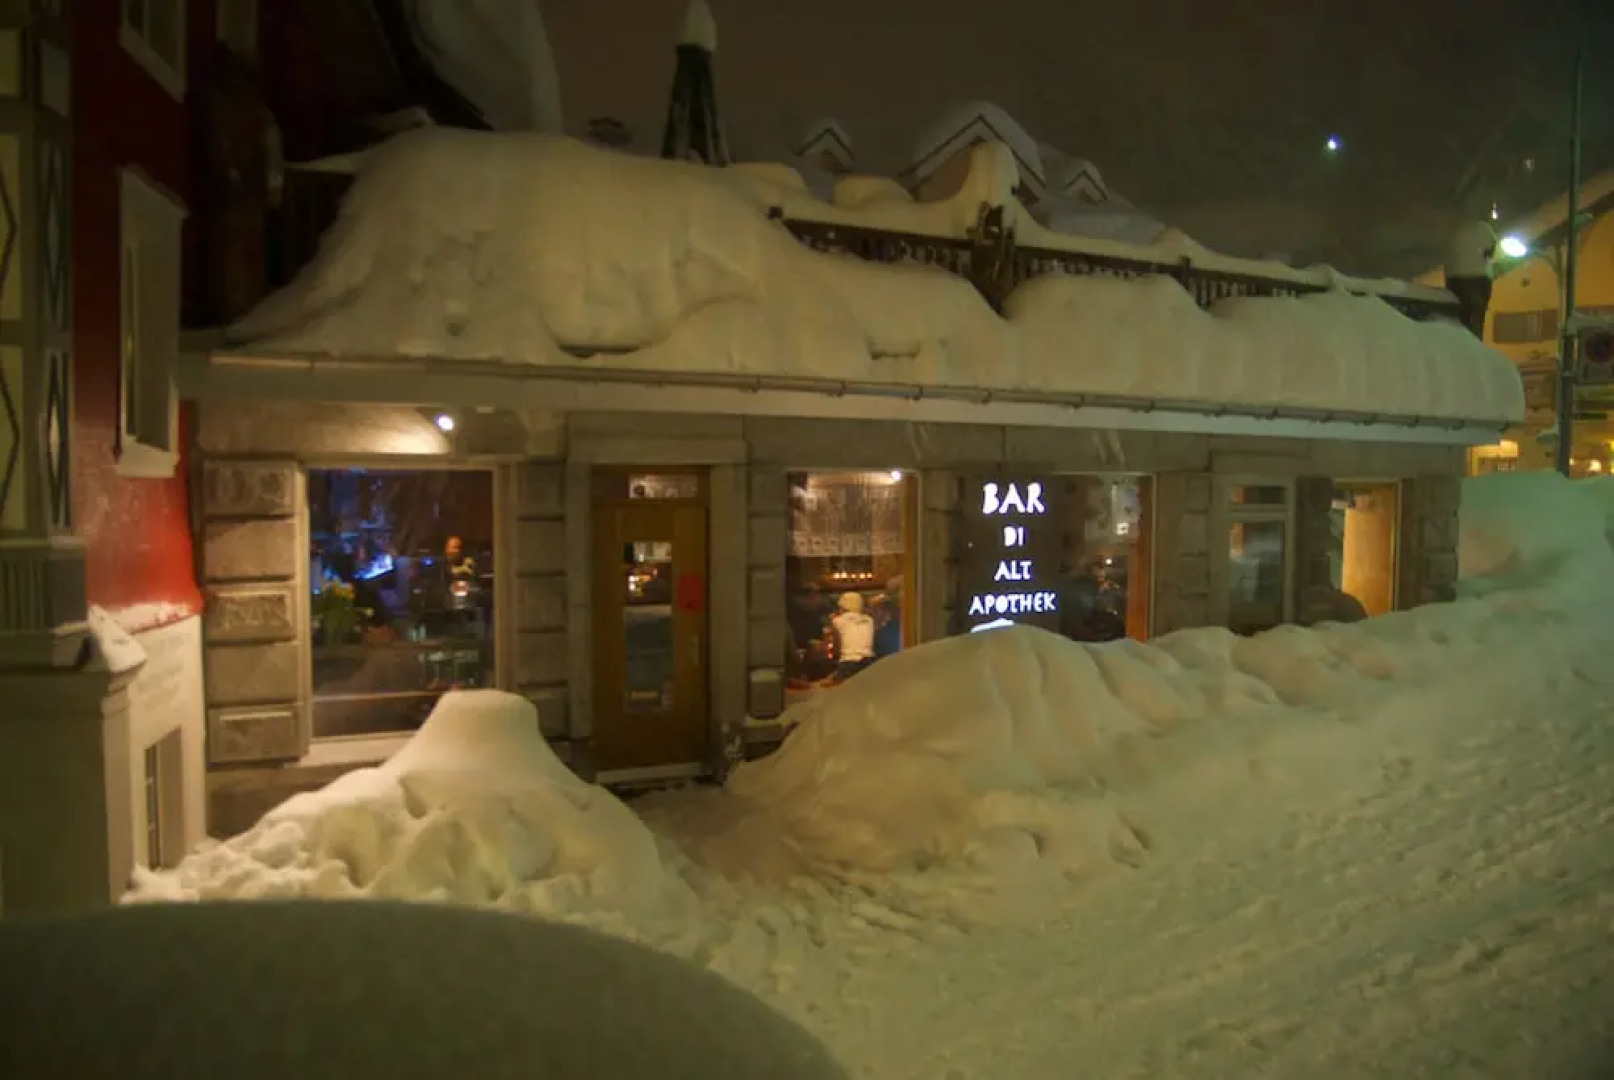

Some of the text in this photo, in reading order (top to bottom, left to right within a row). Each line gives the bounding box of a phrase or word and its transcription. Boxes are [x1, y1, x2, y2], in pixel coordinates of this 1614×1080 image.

[982, 482, 1044, 514] BAR
[1003, 526, 1024, 547] DI
[993, 560, 1032, 582] ALT
[969, 591, 1056, 615] APOTHEK
